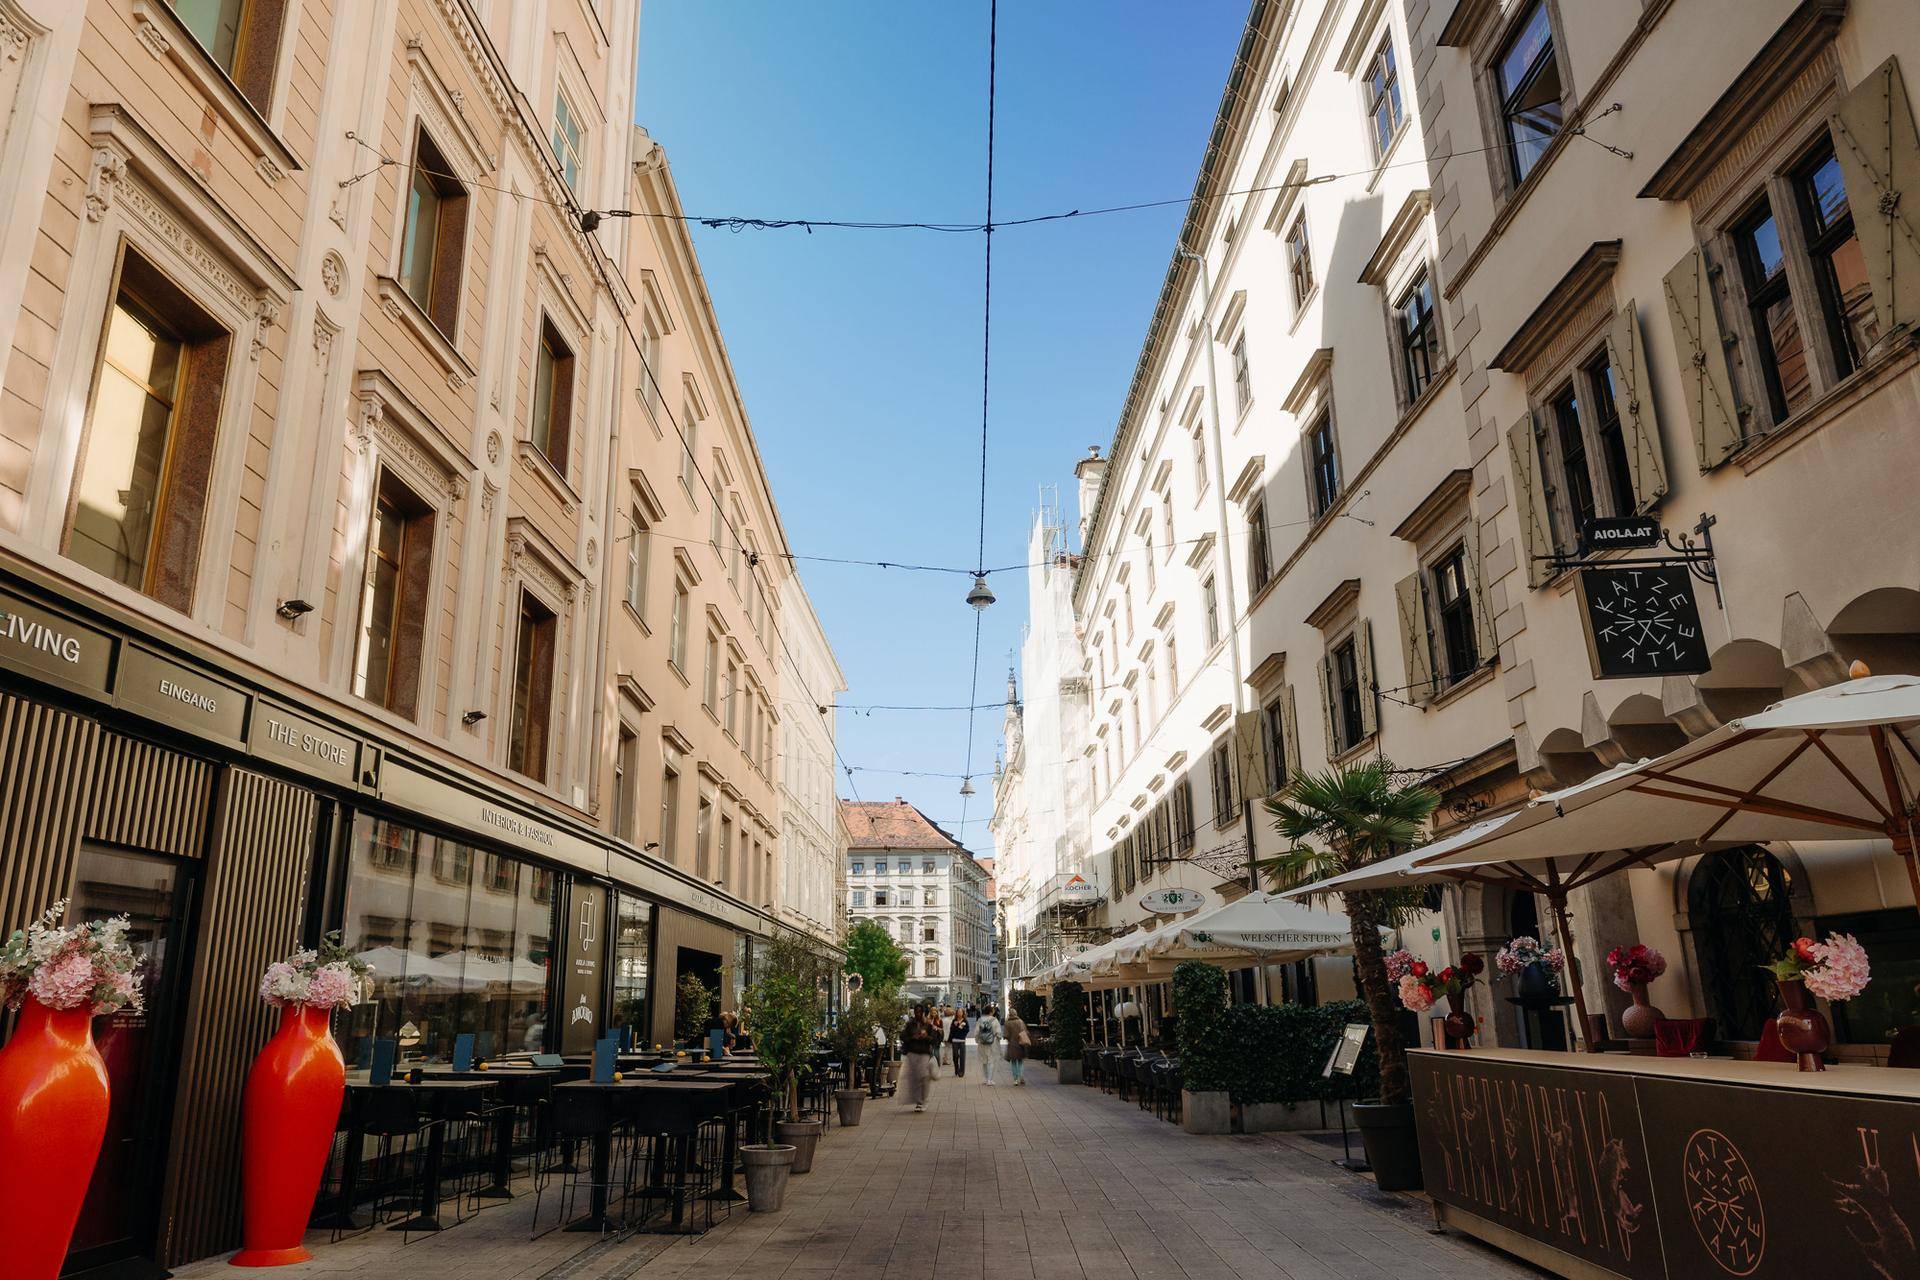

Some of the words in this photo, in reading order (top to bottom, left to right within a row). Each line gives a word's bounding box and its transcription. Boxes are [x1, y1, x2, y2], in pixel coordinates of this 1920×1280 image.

[1594, 526, 1652, 540] AIOLA.AT
[0, 613, 80, 663] IVING
[159, 679, 217, 713] EINGANG
[266, 719, 298, 747] THE
[301, 733, 348, 766] STORE
[482, 807, 517, 833] INTERIOR
[524, 824, 553, 847] FASHION
[1240, 932, 1300, 943] WELSCHER
[1302, 933, 1342, 944] STUB'N
